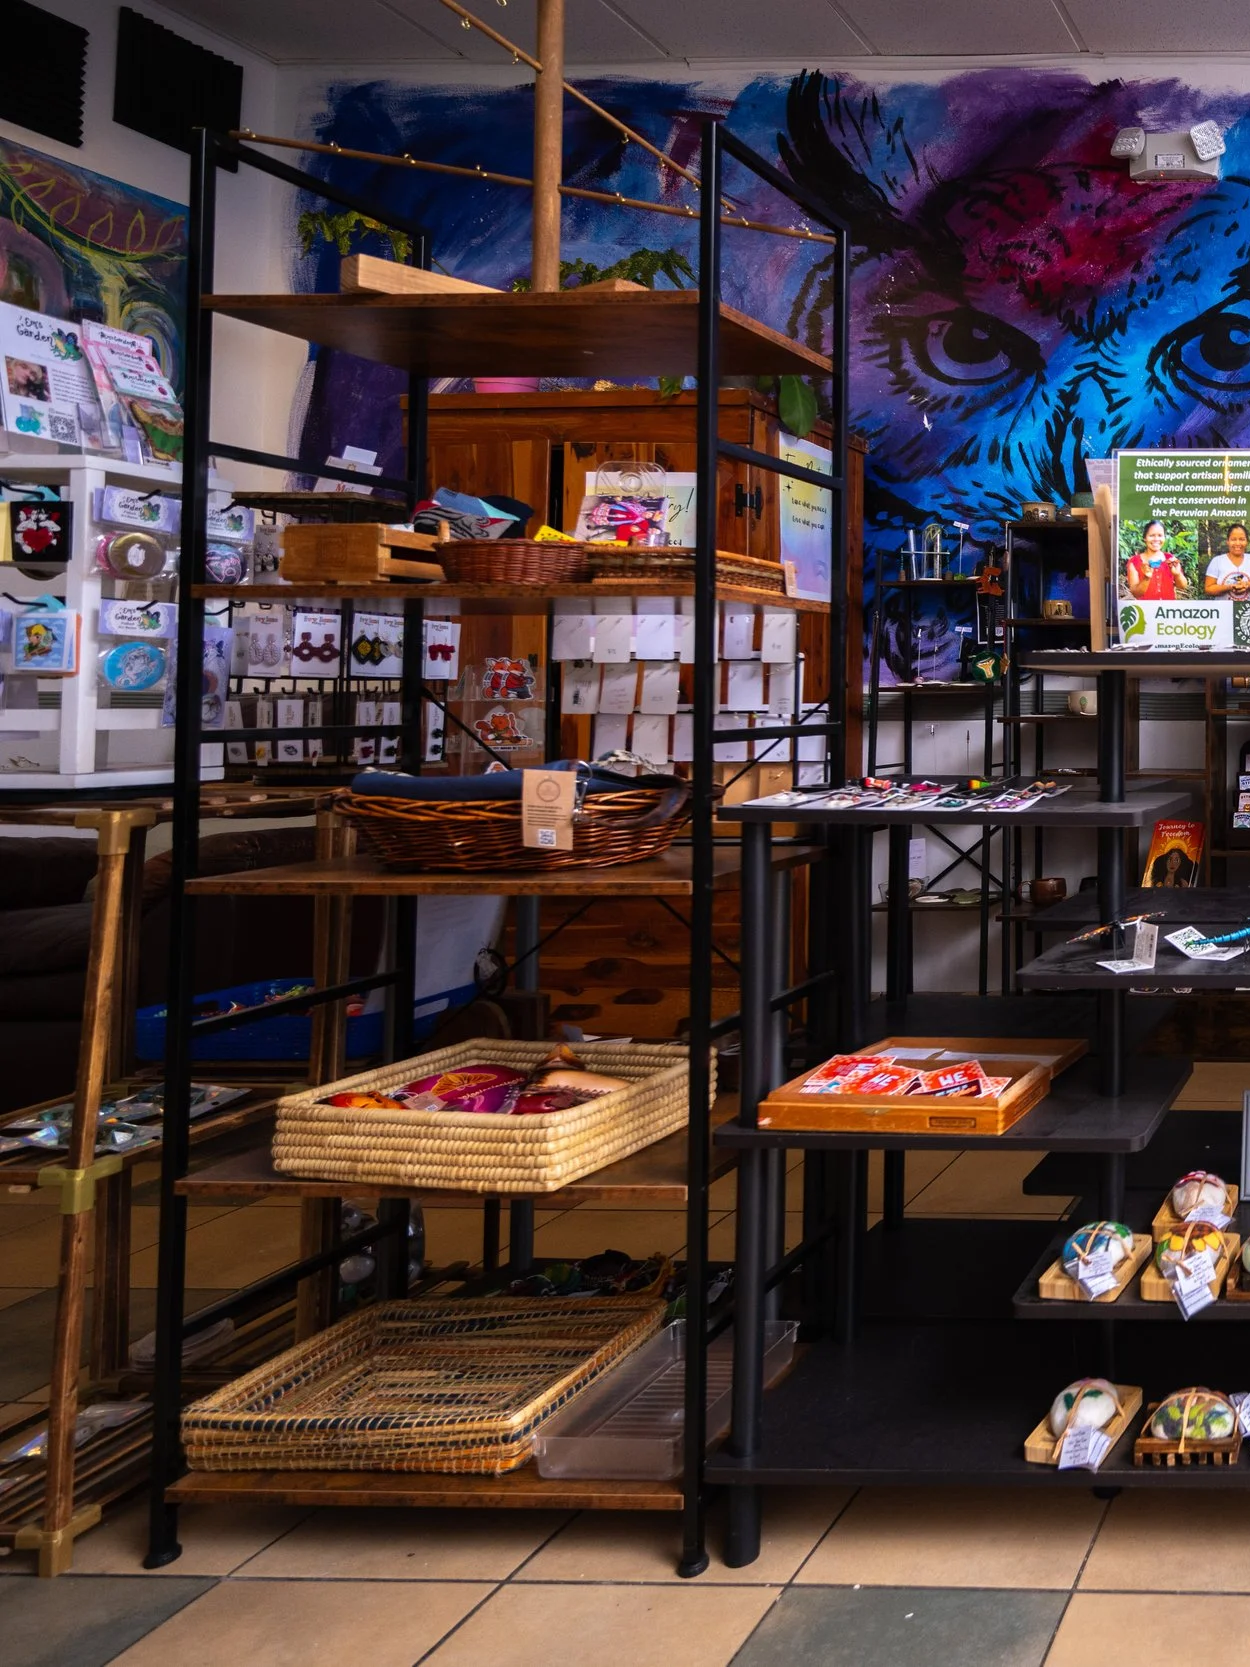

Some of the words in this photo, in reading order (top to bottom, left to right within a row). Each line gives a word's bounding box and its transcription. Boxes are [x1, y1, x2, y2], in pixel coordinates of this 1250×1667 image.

[1136, 458, 1174, 468] Ethically
[1176, 459, 1211, 467] sourced
[1134, 471, 1153, 480] that
[1154, 472, 1189, 482] support
[1191, 472, 1223, 480] artisan
[1135, 483, 1183, 492] traditional
[1185, 484, 1242, 492] communities
[1149, 496, 1176, 506] forest
[1178, 497, 1236, 505] conservation
[1237, 496, 1247, 505] in
[1152, 508, 1167, 517] the
[1169, 508, 1209, 517] Peruvian
[1210, 508, 1247, 517] Amazon
[1155, 606, 1220, 619] Amazon
[1157, 623, 1216, 640] Ecology
[937, 1070, 969, 1088] WE
